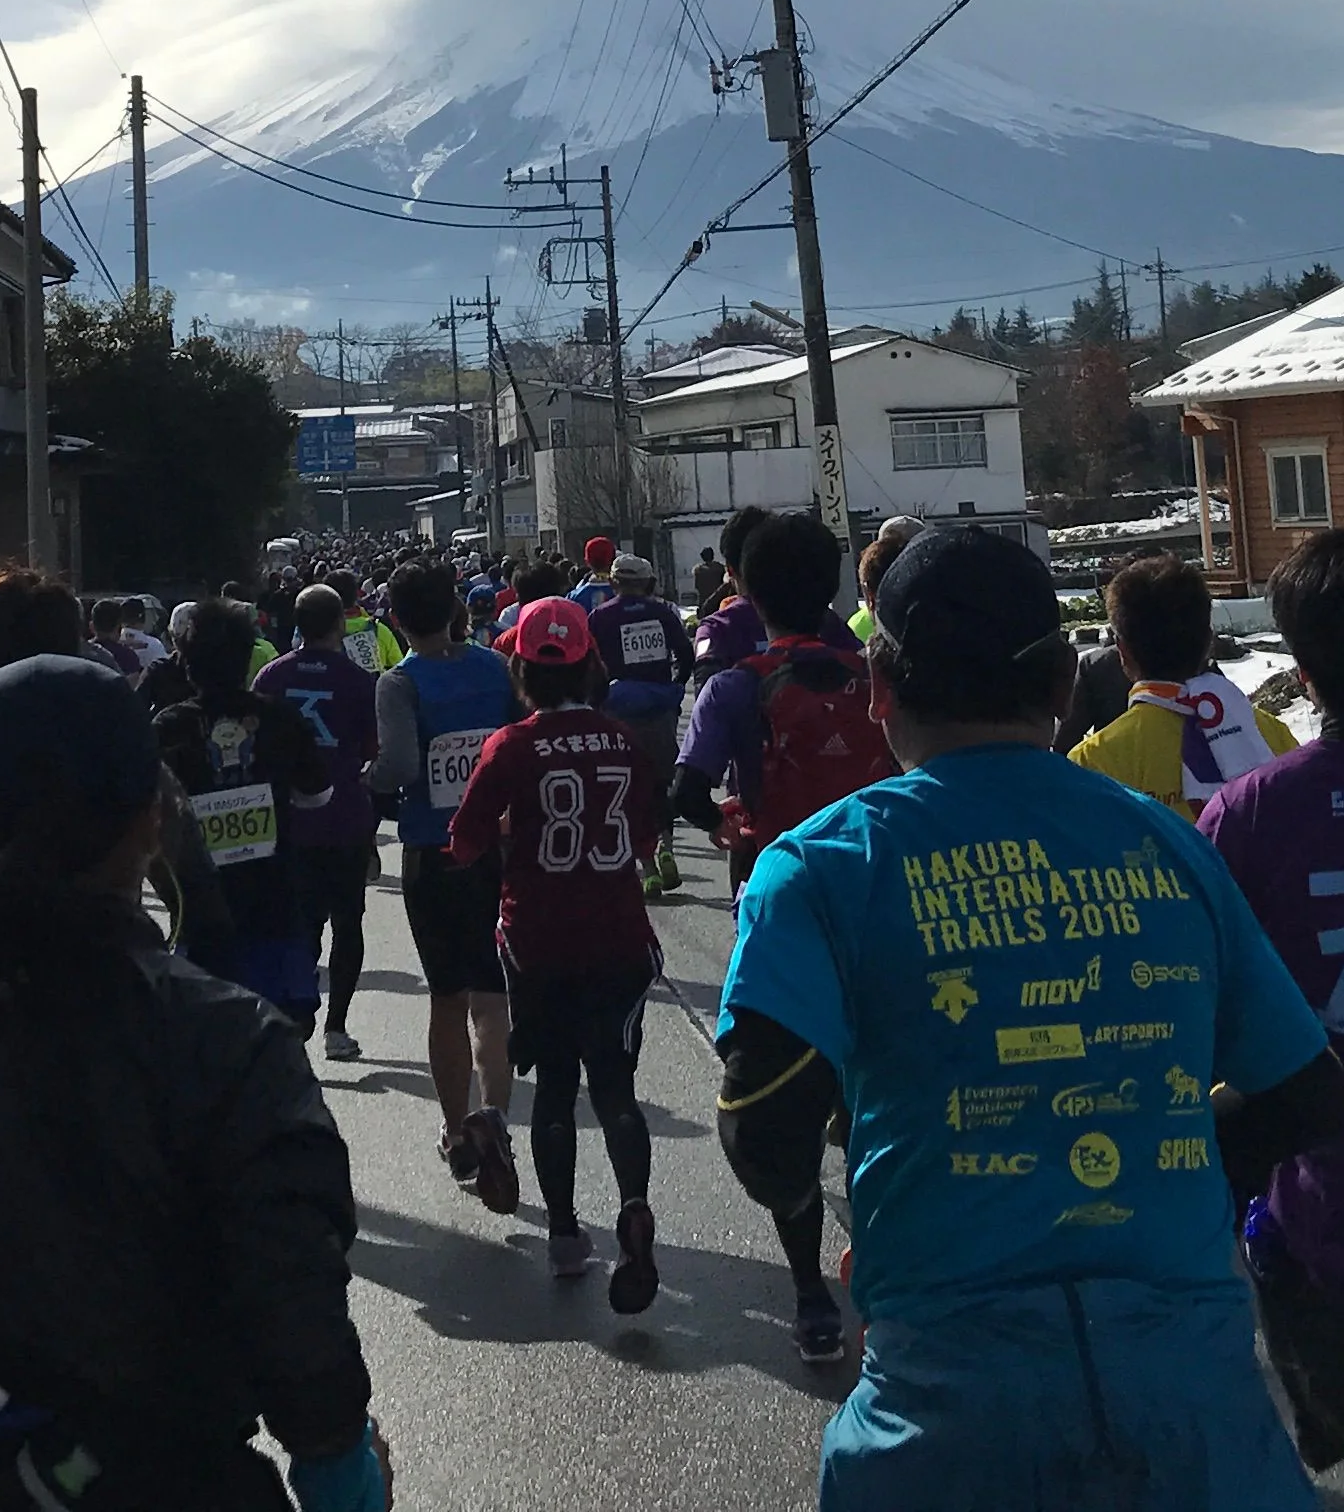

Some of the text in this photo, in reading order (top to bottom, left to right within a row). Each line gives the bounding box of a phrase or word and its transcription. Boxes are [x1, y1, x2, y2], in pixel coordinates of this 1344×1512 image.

[819, 430, 841, 510] メイクィーン
[200, 807, 270, 845] 9867
[537, 766, 632, 873] 83
[903, 839, 1050, 888] HAKUBA
[910, 867, 1190, 921] INTERNATIONAL
[917, 902, 1141, 956] TRAILS 2016
[949, 1152, 1038, 1175] HAC
